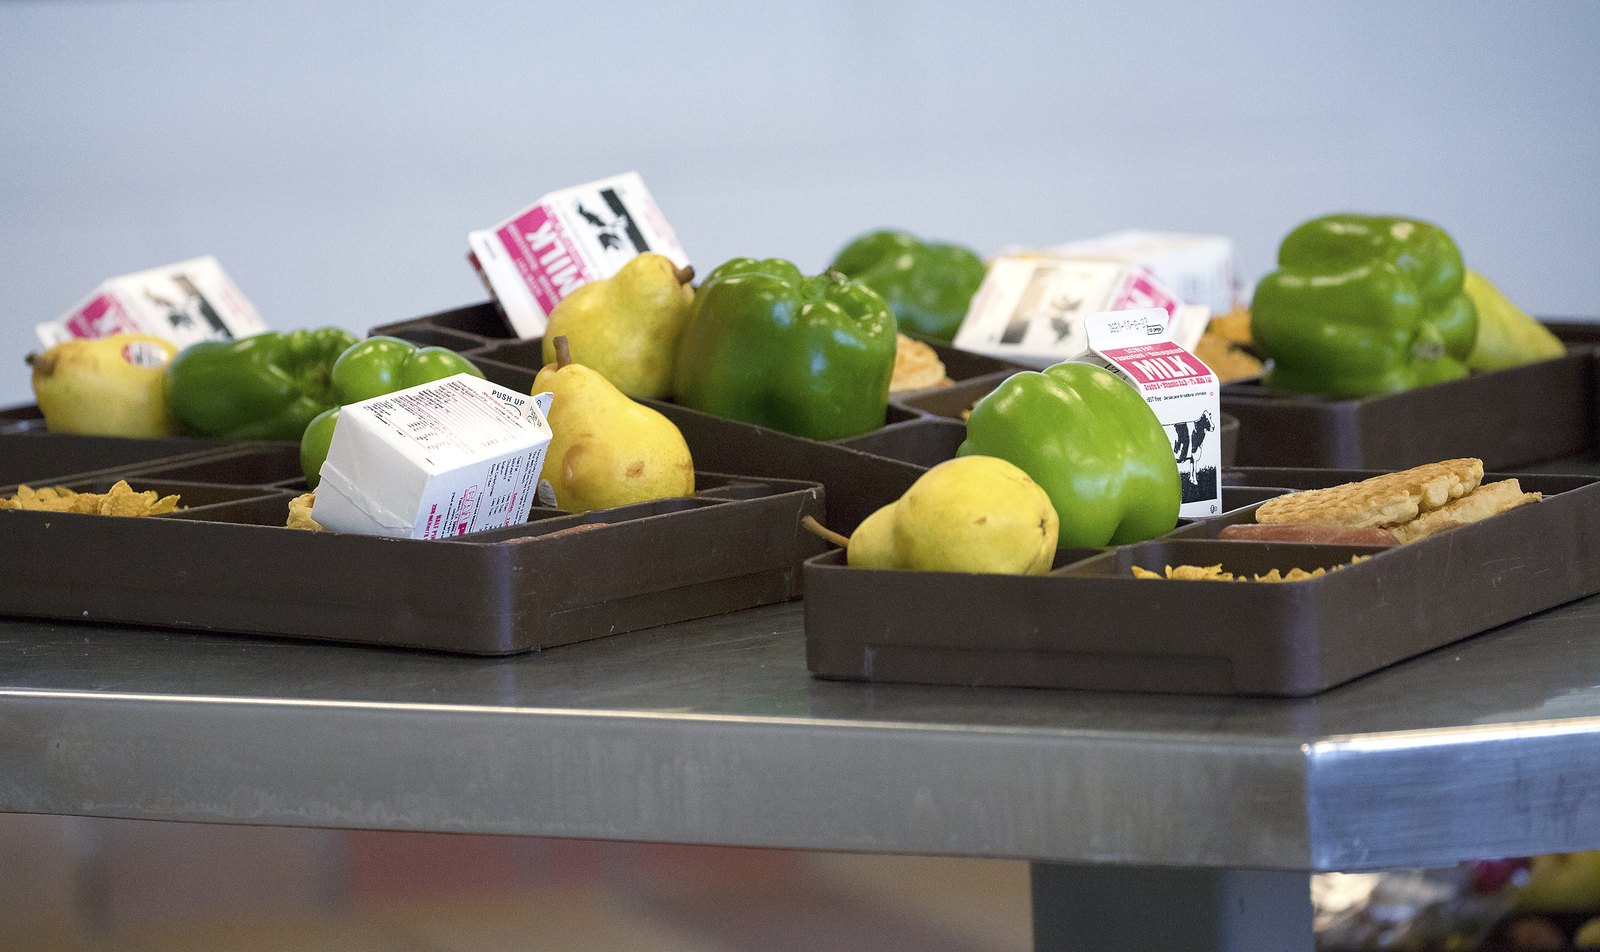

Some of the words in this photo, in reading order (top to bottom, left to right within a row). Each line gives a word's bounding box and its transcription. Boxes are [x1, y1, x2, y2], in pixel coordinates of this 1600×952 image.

[524, 222, 586, 297] MILK
[1132, 356, 1198, 380] MILK
[492, 390, 512, 402] PUSH
[514, 398, 525, 406] UP
